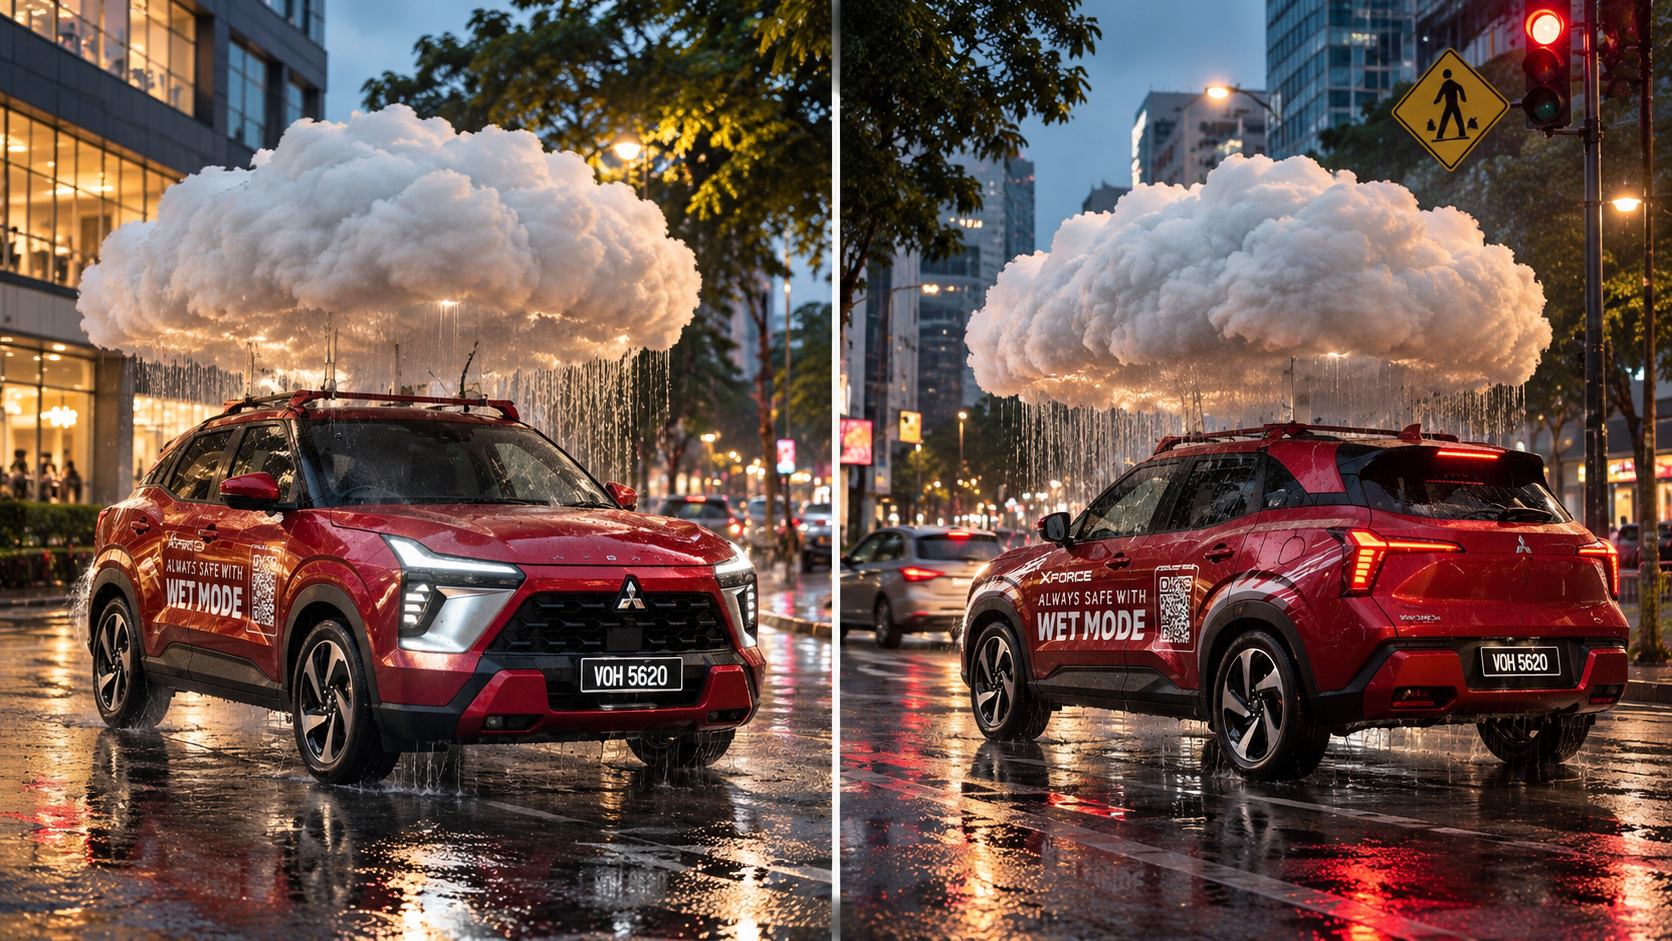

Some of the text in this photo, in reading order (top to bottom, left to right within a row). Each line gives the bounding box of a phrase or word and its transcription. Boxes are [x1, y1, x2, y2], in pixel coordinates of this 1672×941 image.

[199, 561, 219, 577] SAFE
[221, 564, 243, 580] WITH
[1039, 570, 1092, 584] XFORCE
[166, 578, 243, 619] WET MODE
[1038, 589, 1147, 606] ALWAYS SAFE WITH
[1037, 609, 1146, 642] WET MODE
[1492, 653, 1548, 671] VOH 5620
[594, 665, 667, 687] VOH 5620
